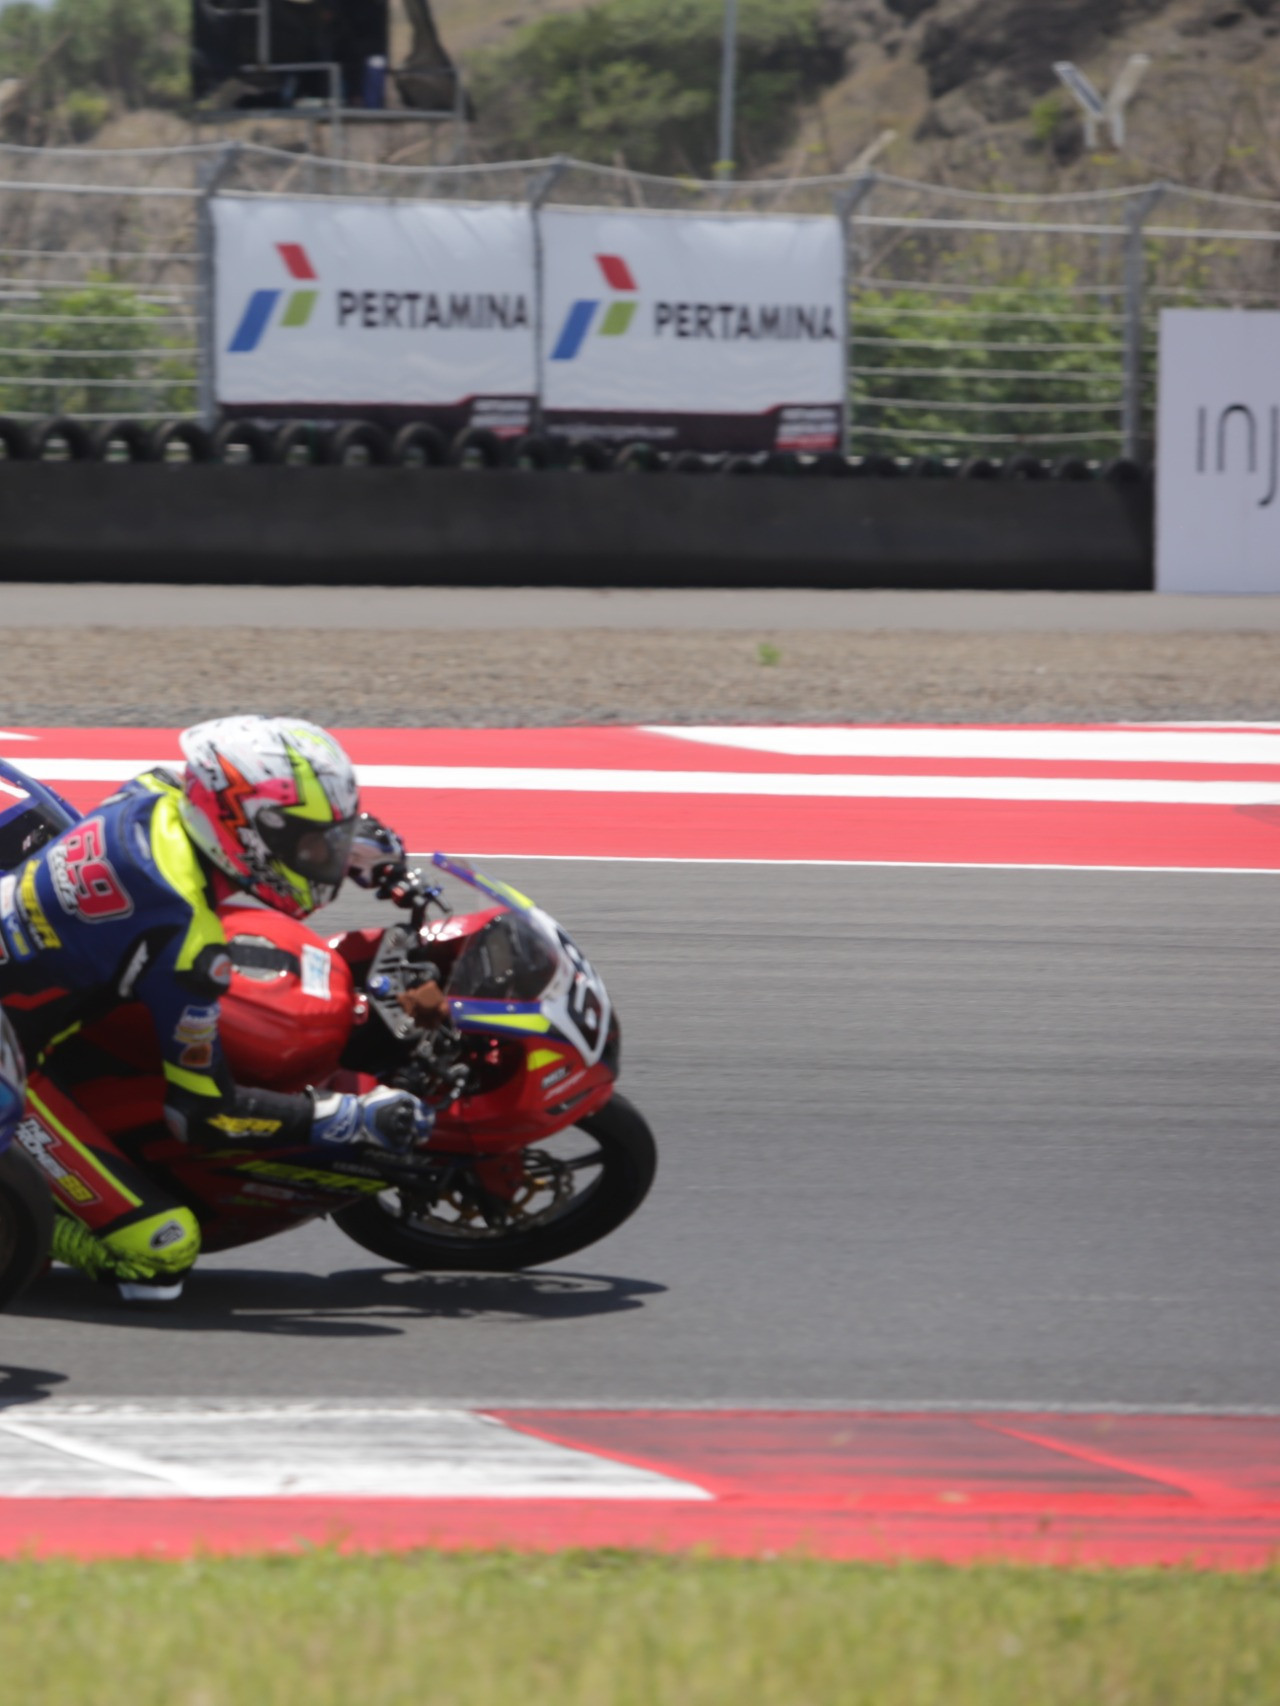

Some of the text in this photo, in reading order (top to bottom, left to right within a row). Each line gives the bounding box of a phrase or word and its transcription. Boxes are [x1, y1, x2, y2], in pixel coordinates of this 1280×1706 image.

[336, 290, 530, 329] PERTAMINA
[654, 302, 837, 340] PERTAMINA
[62, 818, 132, 917] 69
